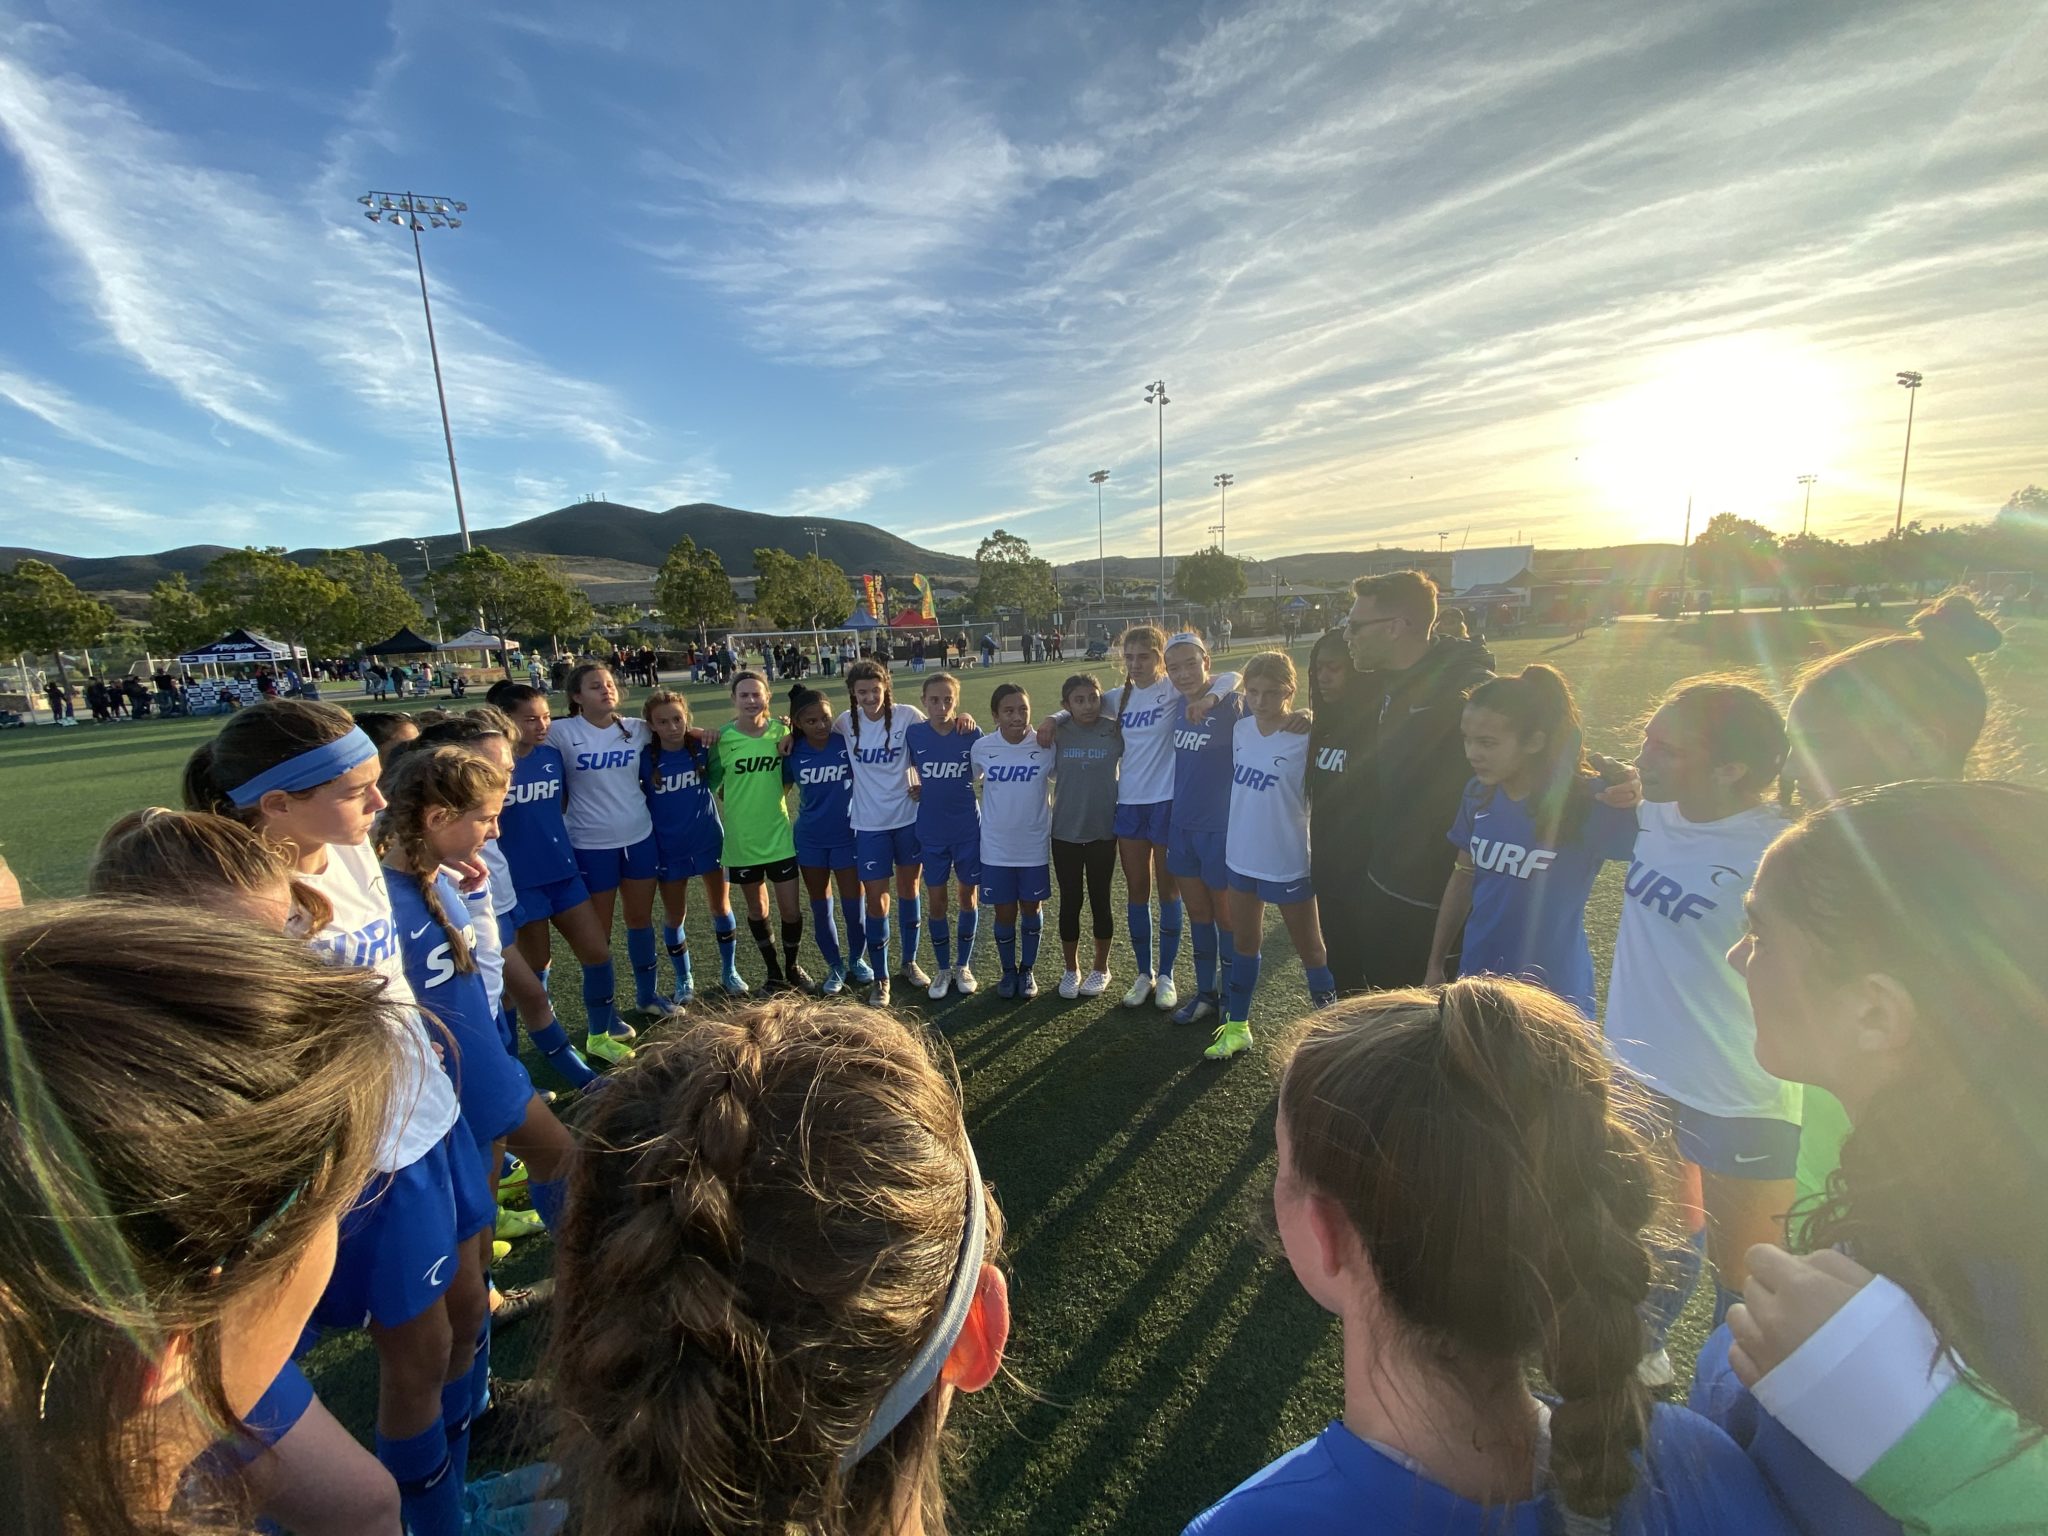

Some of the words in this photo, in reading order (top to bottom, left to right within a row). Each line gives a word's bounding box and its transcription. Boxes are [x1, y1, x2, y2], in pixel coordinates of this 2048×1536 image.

[576, 750, 636, 771] SURF
[855, 747, 902, 764] SURF
[1063, 748, 1086, 759] SURF
[1088, 748, 1108, 759] CUP
[1315, 747, 1347, 772] UR
[735, 756, 783, 774] SURF
[800, 763, 849, 785] SURF
[922, 761, 970, 778] SURF
[987, 765, 1041, 783] SURF
[1233, 763, 1280, 791] URF
[503, 779, 560, 807] SURF
[1624, 860, 1719, 923] URF
